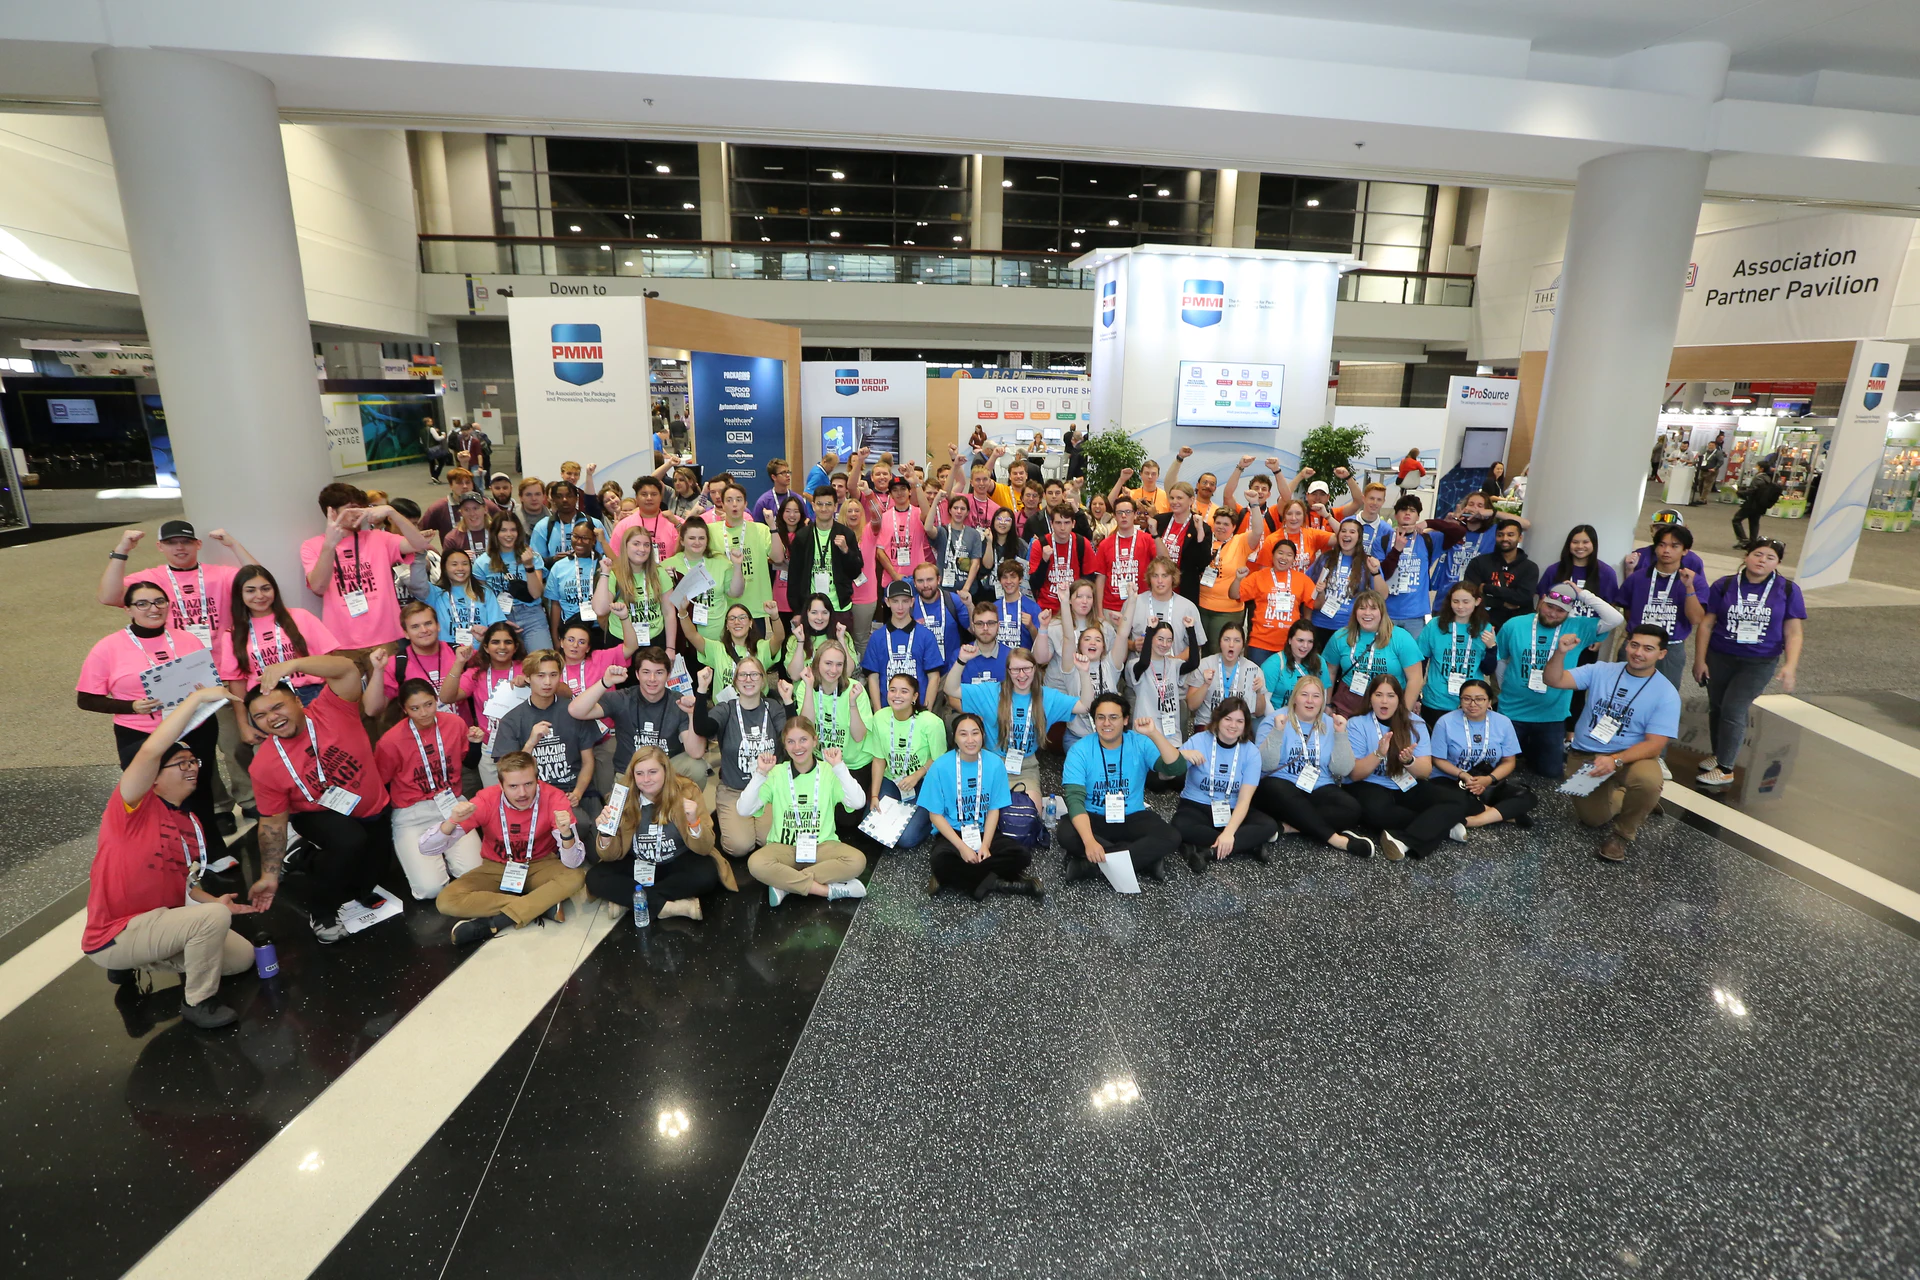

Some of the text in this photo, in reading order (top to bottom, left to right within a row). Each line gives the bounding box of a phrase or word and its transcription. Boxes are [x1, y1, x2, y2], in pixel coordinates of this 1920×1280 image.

[1733, 249, 1857, 278] Association
[550, 282, 607, 296] Down to
[1705, 275, 1879, 307] Partner Pavilion
[1182, 297, 1224, 309] PMMI
[1535, 293, 1555, 304] THE
[552, 346, 603, 360] PMMI
[658, 384, 670, 393] Hall
[996, 386, 1018, 394] PACK
[1021, 386, 1044, 394] EXPO
[1081, 387, 1092, 395] SH
[1866, 379, 1887, 391] PMMI
[1469, 387, 1510, 400] ProSource
[326, 427, 360, 438] NNOVATION
[727, 432, 752, 441] OEM
[337, 436, 361, 446] STAGE
[333, 561, 372, 575] MAZNG
[1726, 619, 1770, 637] RE
[1522, 648, 1551, 657] AMAZIN
[1354, 656, 1387, 665] AMAING
[1442, 656, 1476, 664] PAKAGNG
[1521, 656, 1548, 665] PAKAG
[1593, 705, 1632, 725] PACAGNG
[1012, 723, 1036, 733] MAZNG
[1588, 714, 1629, 737] RE
[532, 743, 566, 757] AMAZING
[1011, 740, 1036, 754] ACE
[305, 745, 340, 785] AMZING
[536, 752, 567, 765] ACKAGING
[322, 755, 362, 792] ACE
[956, 793, 990, 804] MAZNG
[956, 803, 990, 812] ACKAING
[780, 828, 820, 845] RAE
[638, 838, 675, 851] AMAZNG
